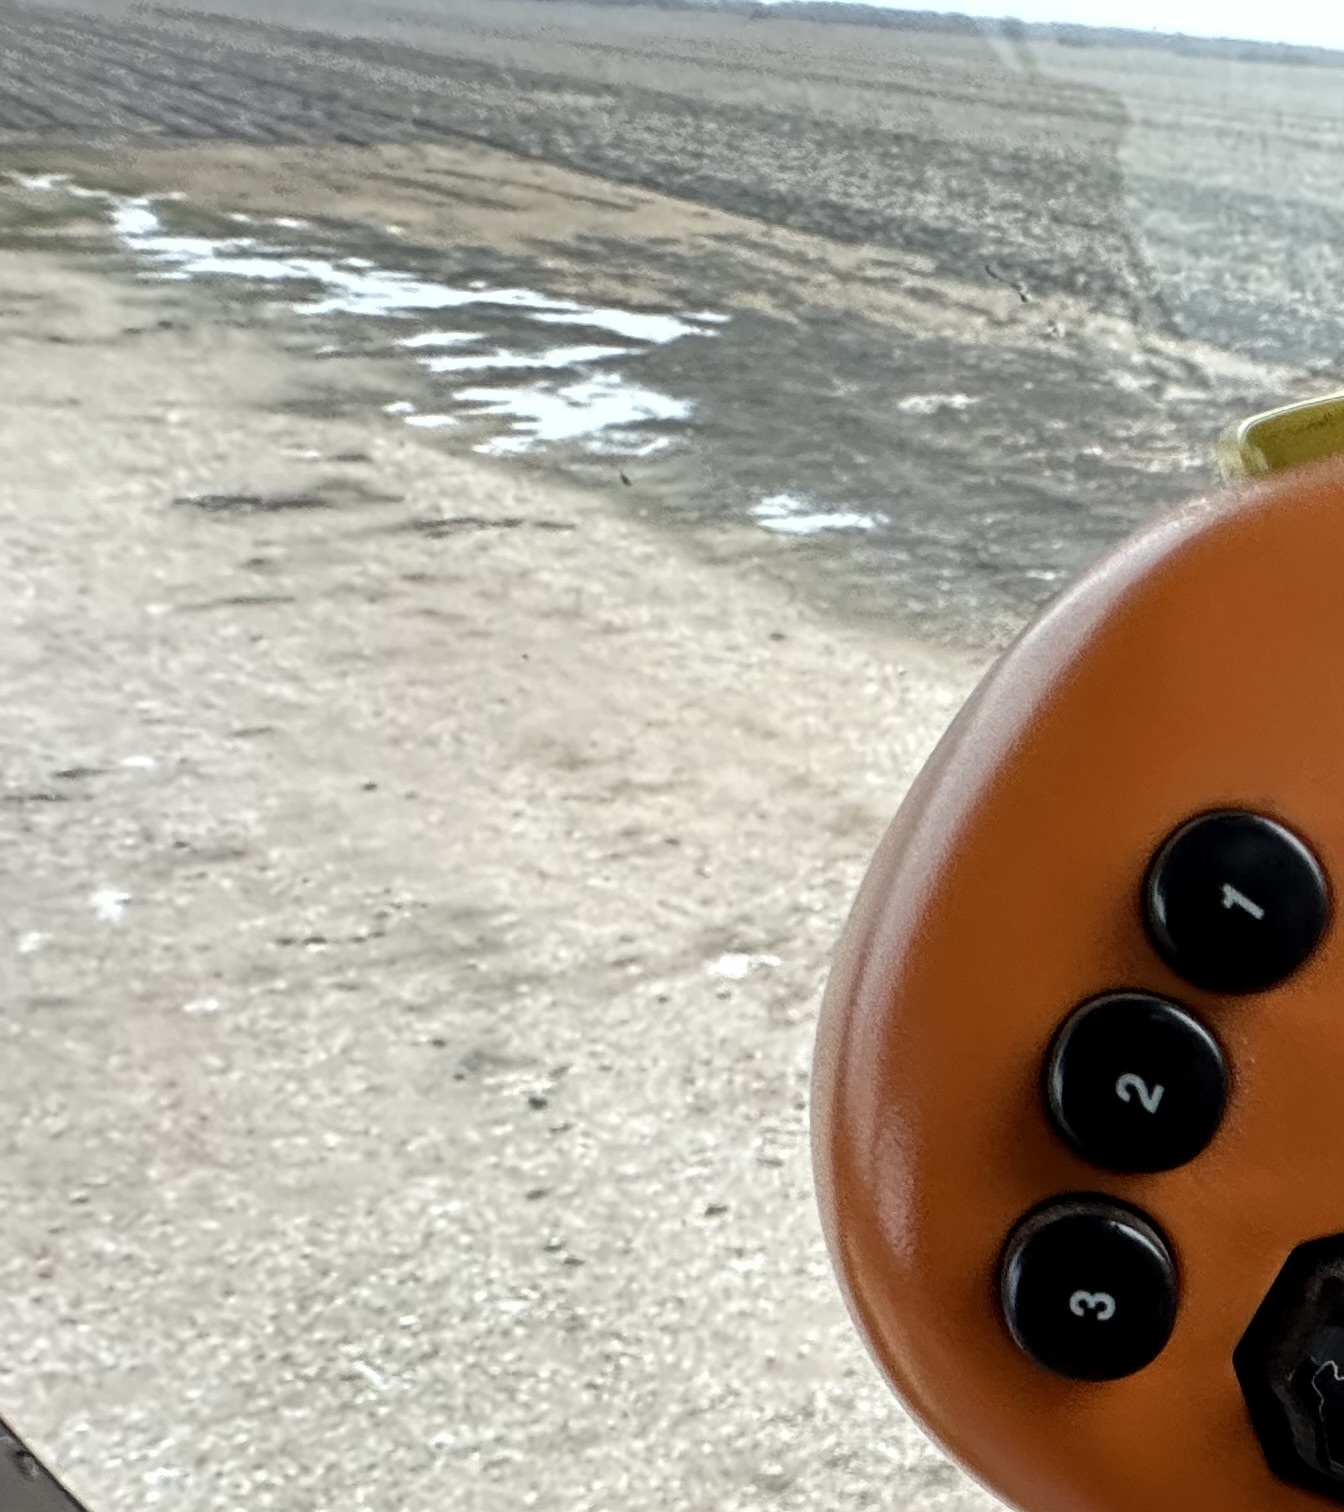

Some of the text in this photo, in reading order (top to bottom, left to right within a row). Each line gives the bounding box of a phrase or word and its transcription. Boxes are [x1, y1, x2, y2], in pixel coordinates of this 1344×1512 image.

[1221, 883, 1265, 921] 1
[1115, 1072, 1165, 1115] 2
[1068, 1289, 1116, 1321] 3
